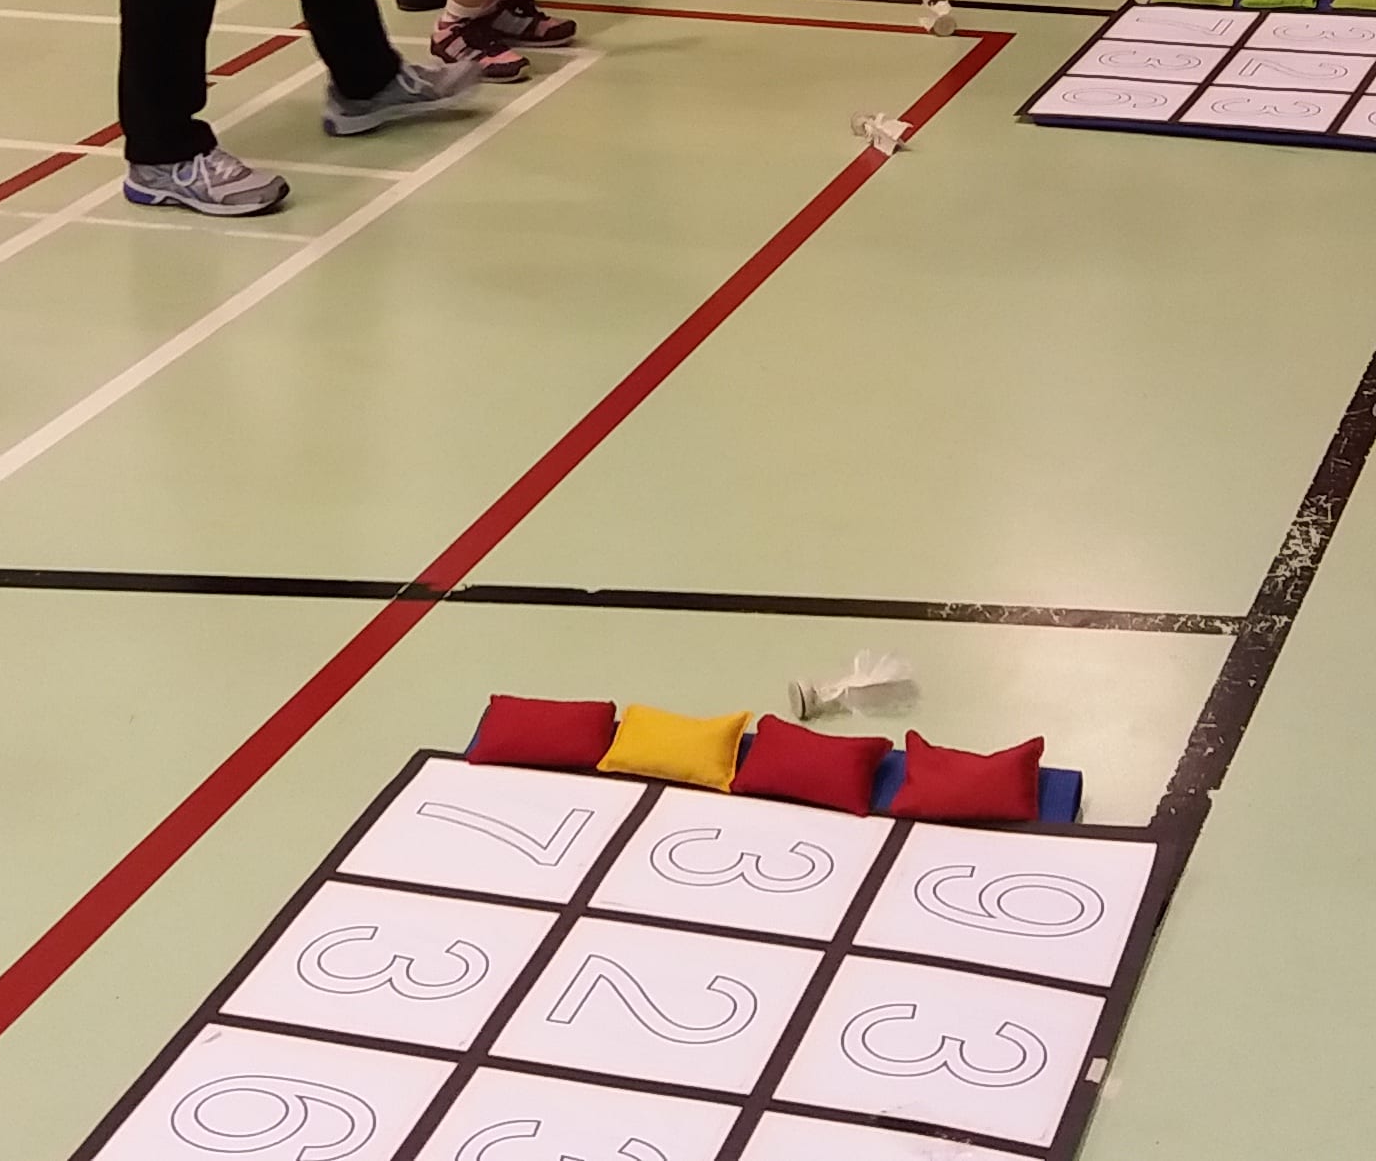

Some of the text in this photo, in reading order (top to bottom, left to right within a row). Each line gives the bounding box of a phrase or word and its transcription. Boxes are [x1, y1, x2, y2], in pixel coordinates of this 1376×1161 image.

[1135, 17, 1234, 37] 7
[1273, 24, 1376, 42] 3
[1098, 50, 1202, 71] 3
[1238, 57, 1348, 81] 2
[1210, 97, 1322, 119] 3
[417, 801, 595, 867] 7
[649, 827, 835, 894] 3
[914, 865, 1105, 938] 9
[296, 925, 490, 1000] 3
[546, 953, 758, 1045] 2
[840, 1003, 1048, 1088] 3
[170, 1075, 377, 1161] 6
